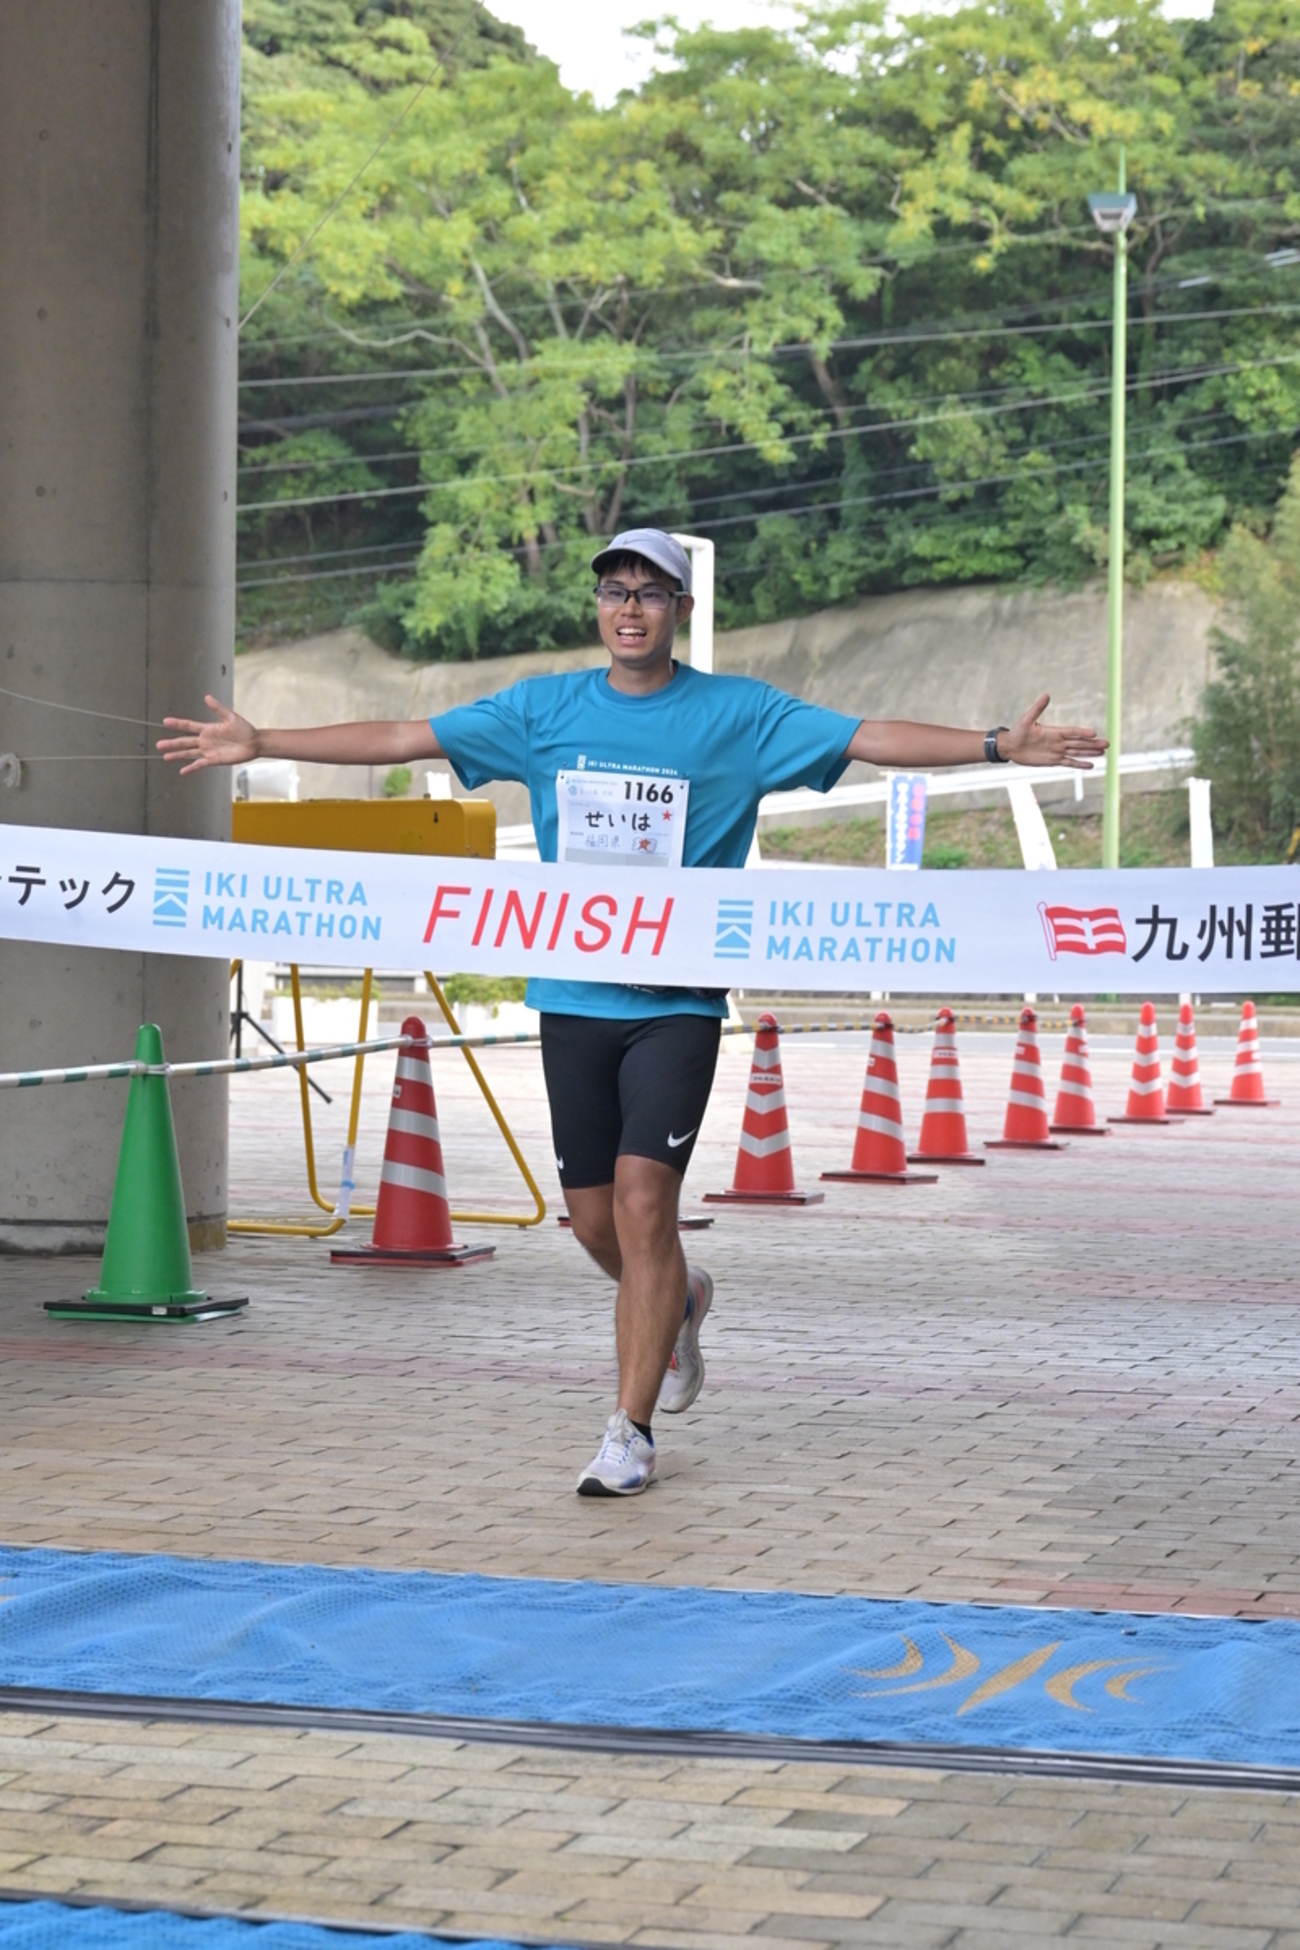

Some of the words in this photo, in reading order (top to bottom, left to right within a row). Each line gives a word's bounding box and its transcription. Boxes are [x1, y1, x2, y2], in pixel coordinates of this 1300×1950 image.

[599, 761, 621, 770] ULTRA
[622, 763, 660, 774] MARATHON
[624, 781, 674, 804] 1166
[584, 811, 651, 832] せいは
[0, 865, 136, 914] テック
[204, 871, 248, 899] IKI
[263, 875, 368, 906] ULTRA
[202, 904, 382, 941] MARATHON
[422, 885, 675, 956] FINISH
[769, 900, 814, 927] IKI
[830, 901, 940, 928] ULTRA
[1132, 902, 1300, 963] 九州郵
[766, 935, 956, 963] MARATHON
